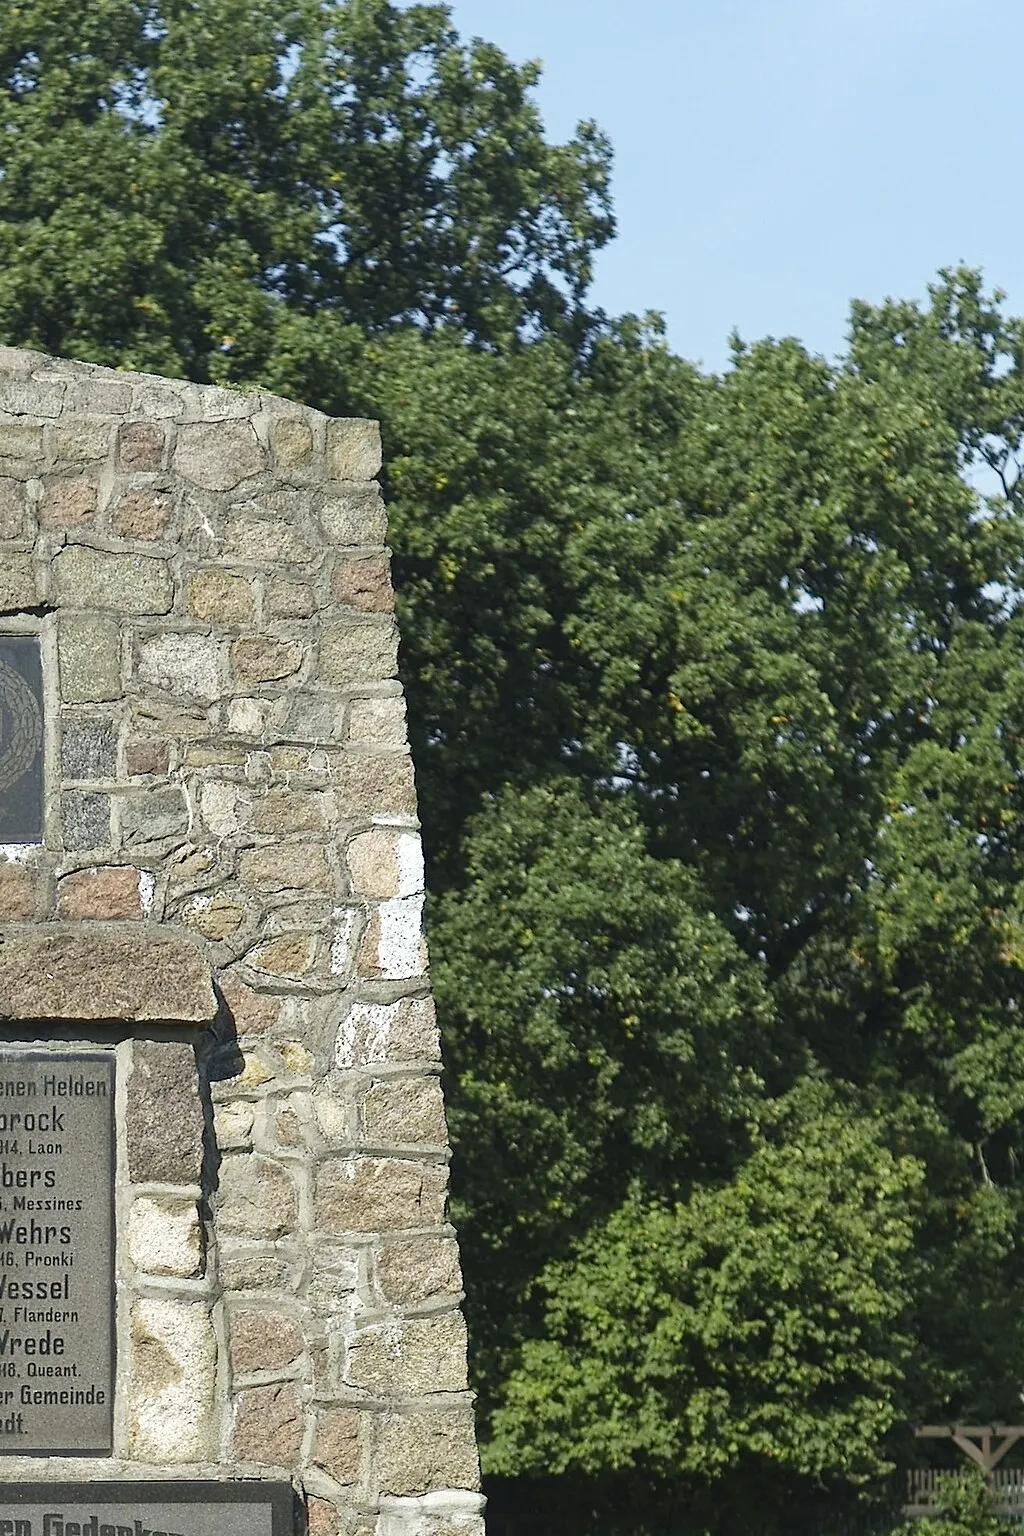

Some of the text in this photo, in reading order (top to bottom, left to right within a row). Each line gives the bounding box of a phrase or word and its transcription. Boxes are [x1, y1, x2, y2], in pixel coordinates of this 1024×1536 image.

[43, 1075, 107, 1097] Helden
[29, 1141, 62, 1154] Laon
[13, 1196, 82, 1211] Messines
[26, 1252, 73, 1266] Pronki
[14, 1308, 78, 1322] Flandern
[21, 1385, 105, 1405] Gemeinde
